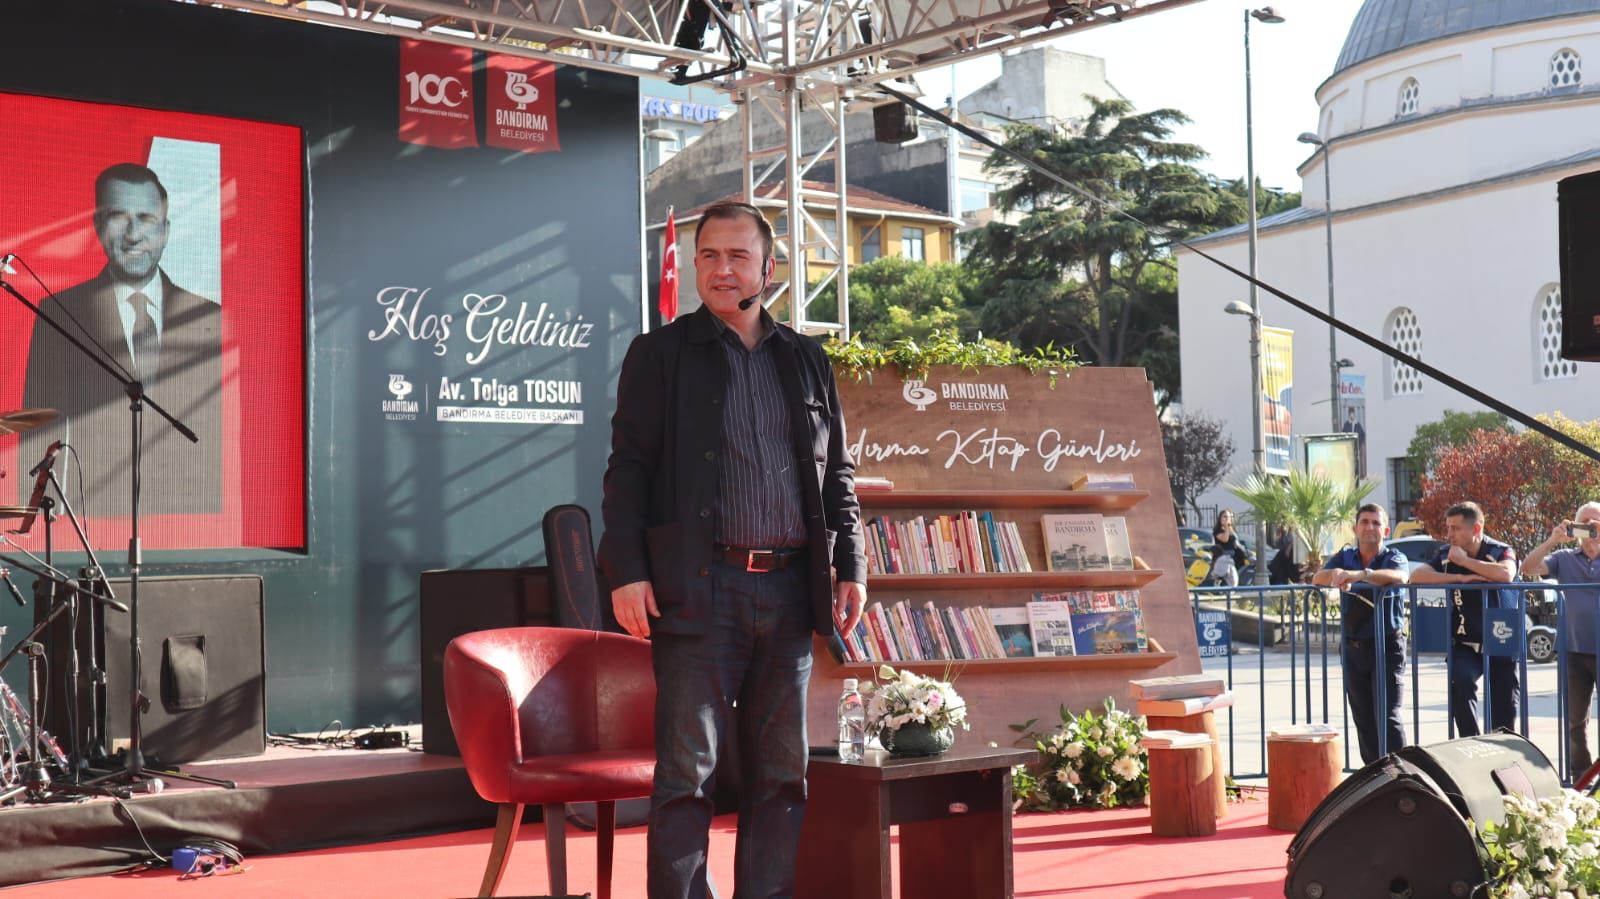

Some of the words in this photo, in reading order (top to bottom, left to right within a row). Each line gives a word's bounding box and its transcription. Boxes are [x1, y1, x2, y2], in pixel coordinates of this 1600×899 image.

[496, 109, 548, 131] BANDIRMA
[500, 129, 544, 142] BELEDİYESİ
[367, 286, 453, 356] Hoş
[463, 293, 595, 365] Geldiniz
[439, 376, 465, 400] Av.
[471, 377, 518, 407] Tolga
[524, 380, 582, 404] TOSUN
[941, 382, 1009, 400] BANDIRMA
[382, 399, 419, 413] BANDIRMA
[949, 400, 1006, 412] BELEDİYESİ
[442, 408, 492, 419] BANDIRMA
[495, 410, 537, 421] BELEDİYE
[540, 412, 578, 423] BAŞKANI
[848, 428, 929, 466] dırma
[936, 427, 1030, 471] Kitap
[1037, 428, 1141, 472] Günleri
[1055, 526, 1097, 535] BANDIRMA
